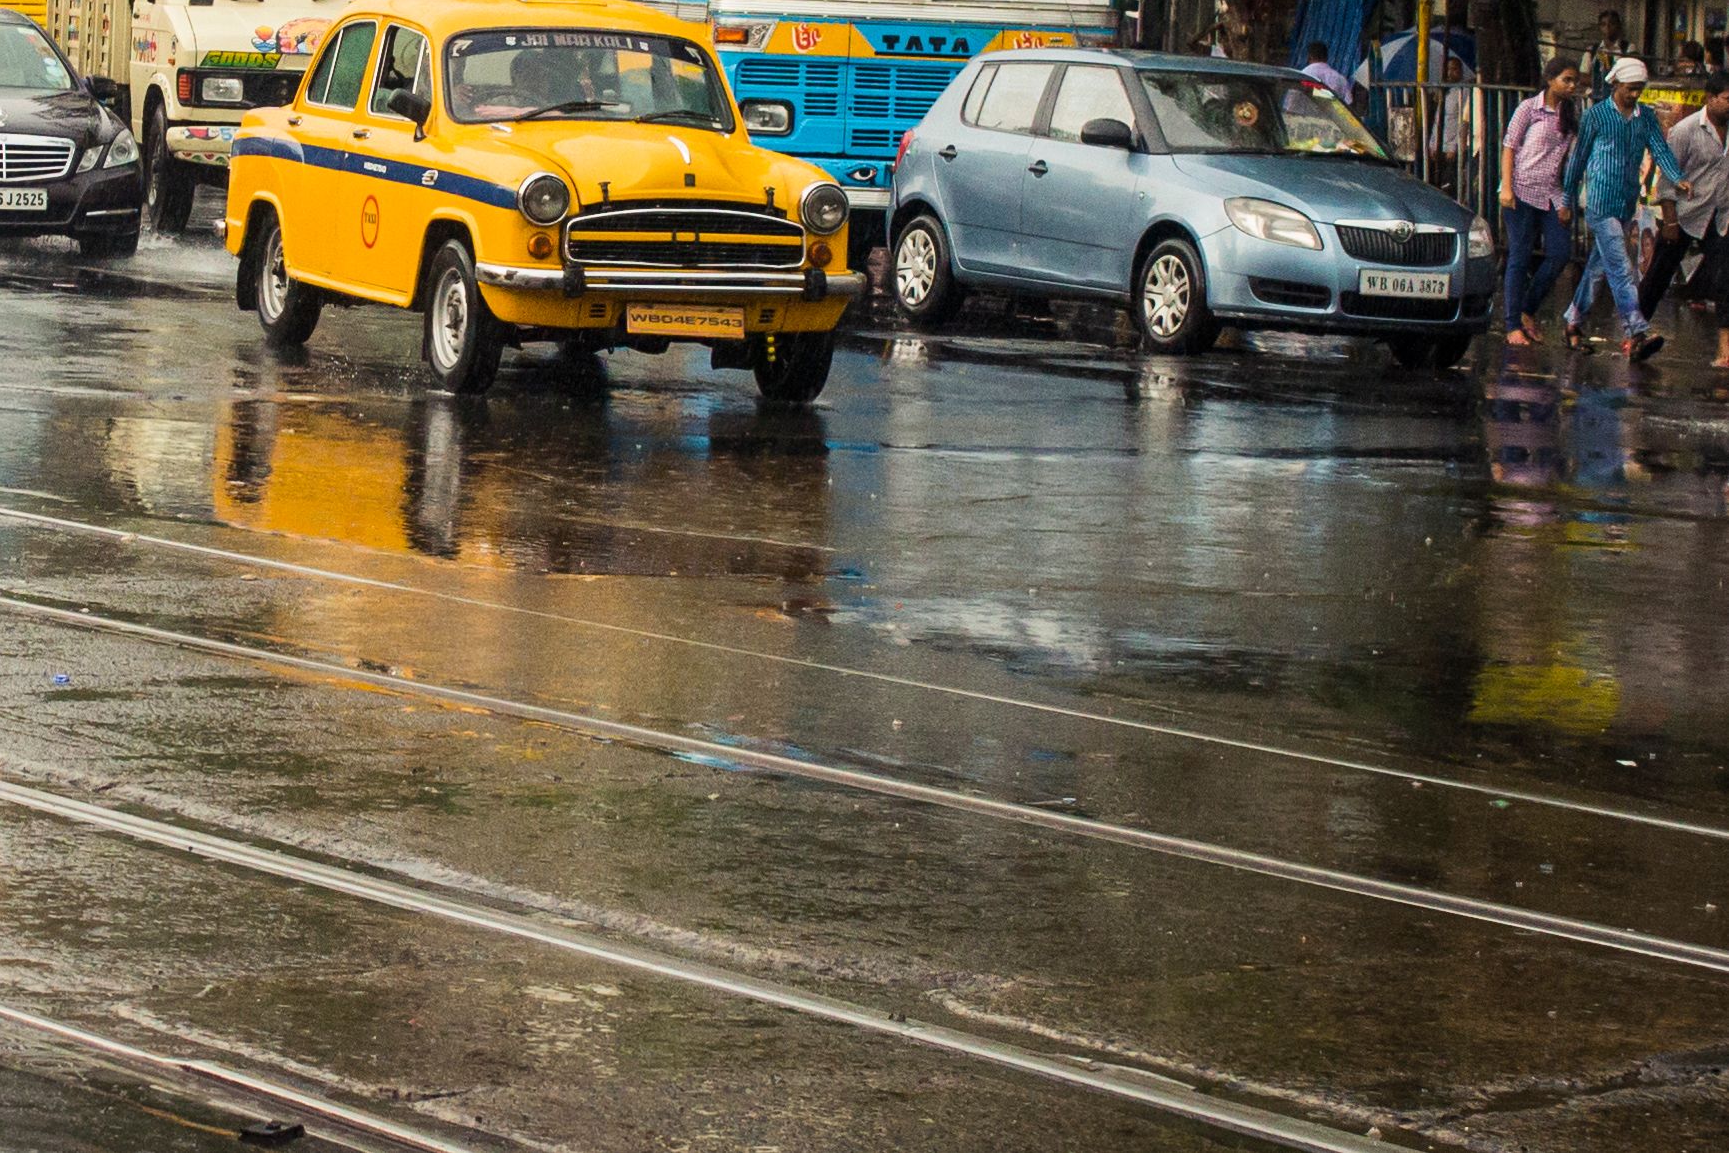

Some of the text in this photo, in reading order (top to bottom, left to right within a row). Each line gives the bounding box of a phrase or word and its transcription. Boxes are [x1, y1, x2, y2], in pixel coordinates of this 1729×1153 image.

[881, 34, 970, 53] TATA
[205, 51, 281, 68] GOODS
[364, 212, 377, 224] TAXI
